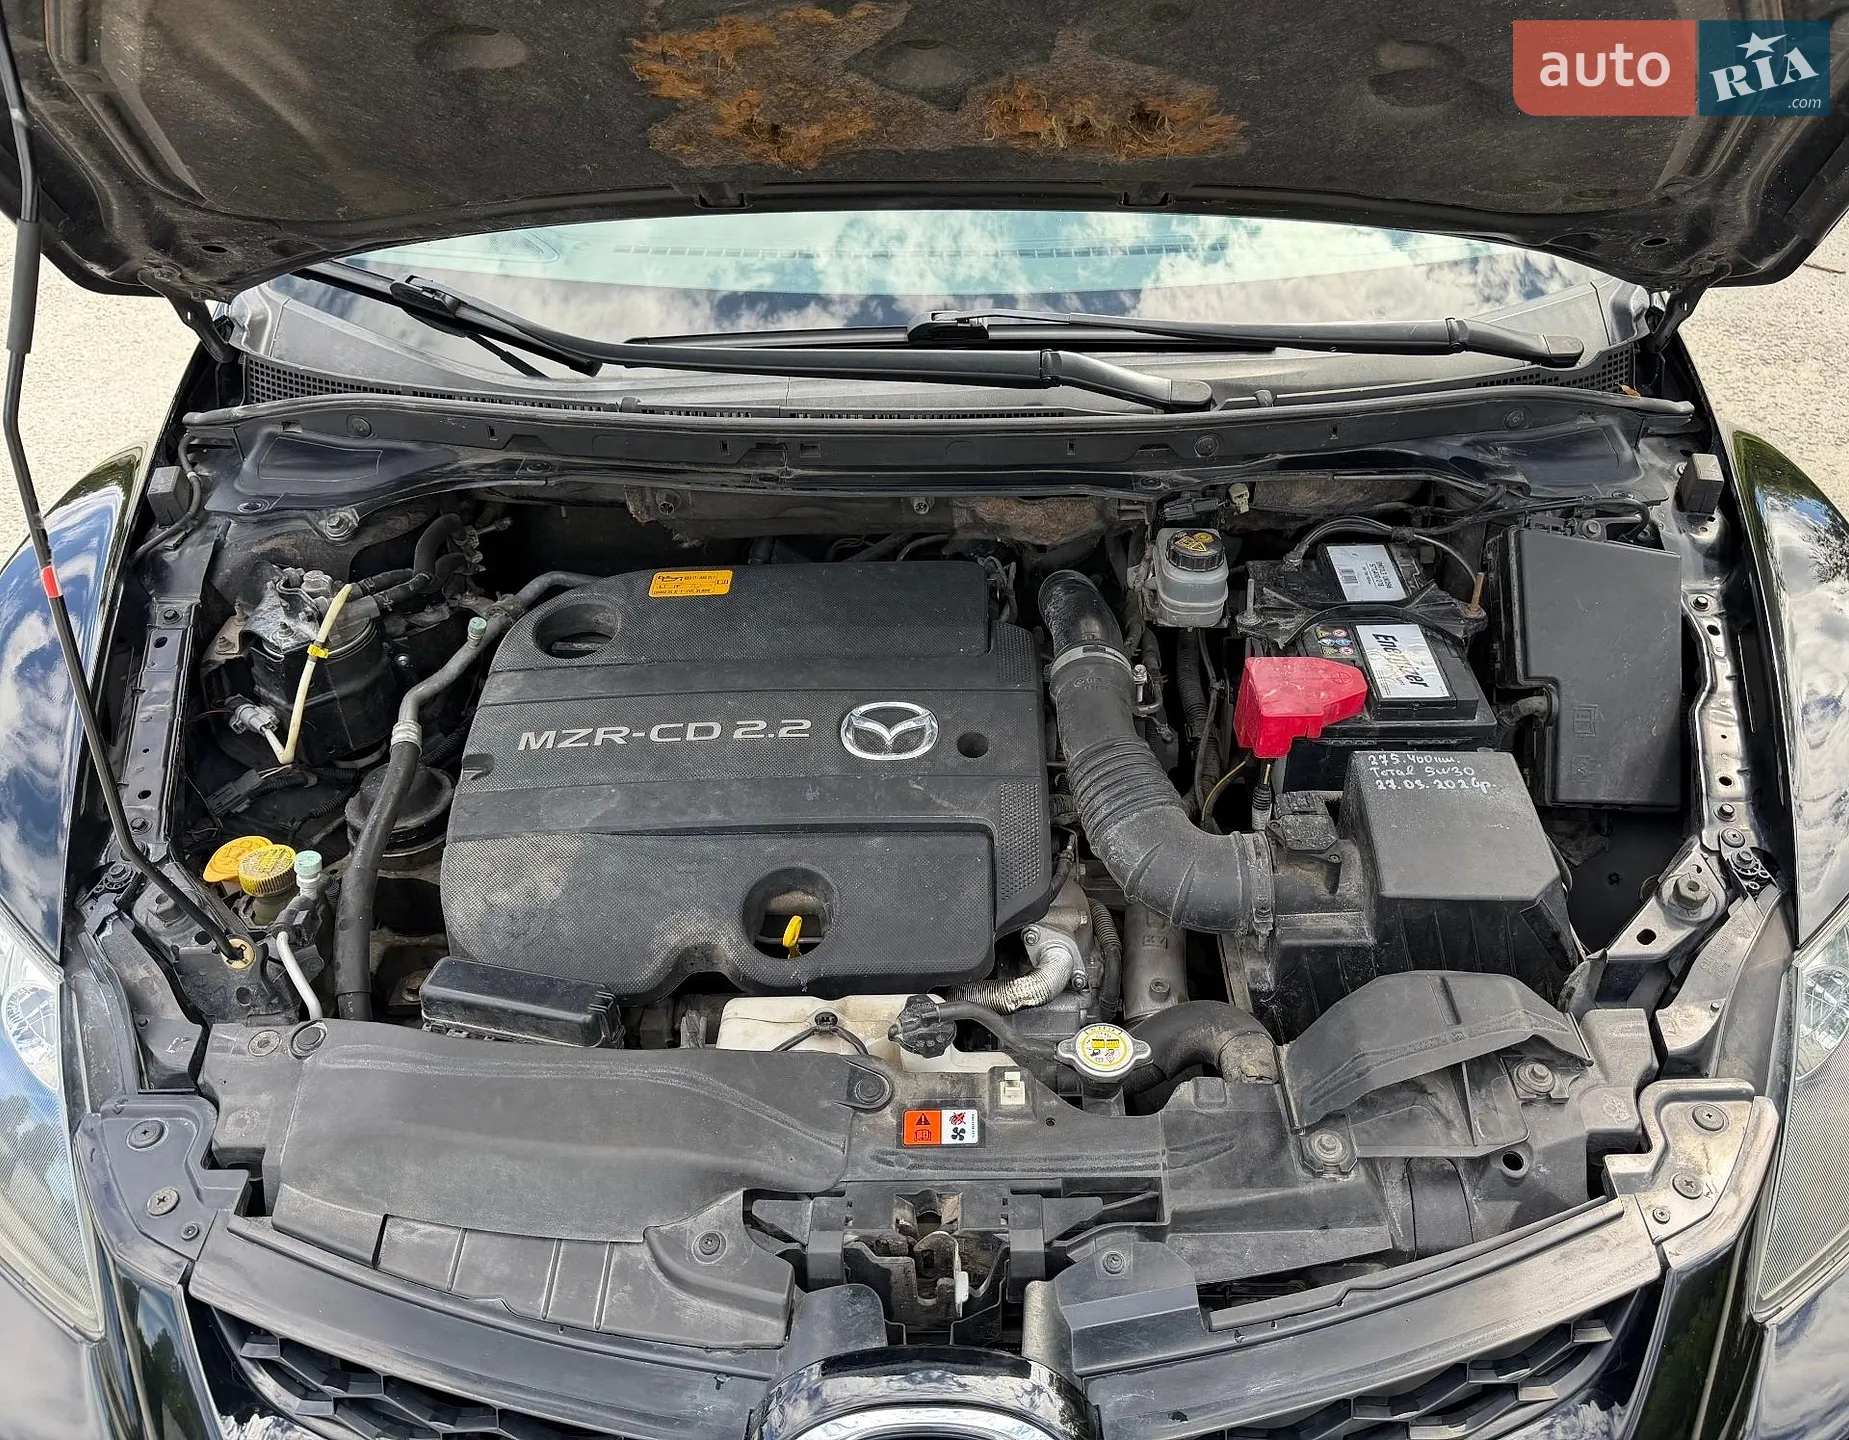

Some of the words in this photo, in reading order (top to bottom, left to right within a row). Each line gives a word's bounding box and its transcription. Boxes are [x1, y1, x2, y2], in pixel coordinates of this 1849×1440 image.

[517, 721, 723, 751] MZR-CD
[732, 719, 812, 740] 2.2
[1369, 765, 1415, 778] Total
